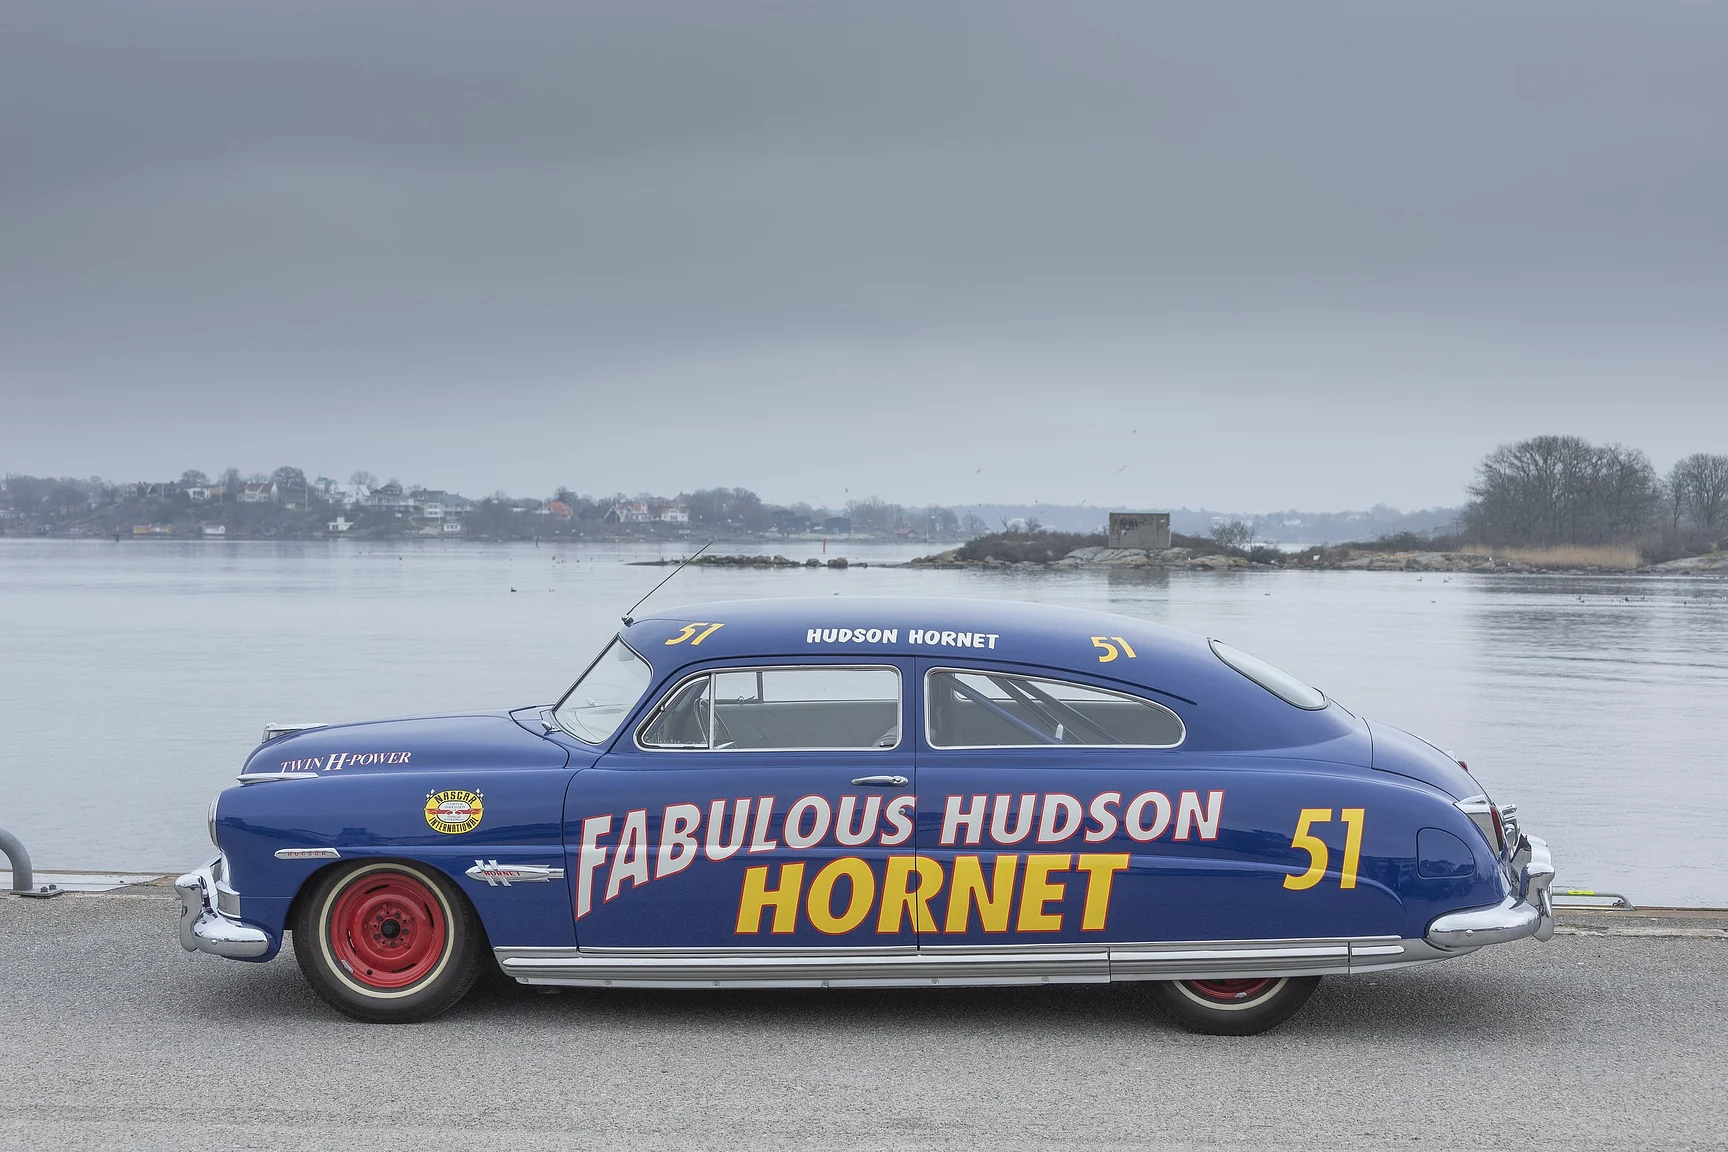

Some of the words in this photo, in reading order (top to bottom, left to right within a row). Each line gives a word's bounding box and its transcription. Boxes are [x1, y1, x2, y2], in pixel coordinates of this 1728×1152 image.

[665, 622, 725, 647] 51
[806, 628, 898, 644] HUDSON
[908, 629, 1000, 651] HORNET
[1090, 635, 1138, 663] 51
[280, 757, 324, 773] TWIN
[323, 751, 412, 771] H-POWER
[433, 791, 478, 804] NASCAR
[428, 816, 479, 833] INTERNATIONAL
[575, 793, 917, 922] FABULOUS
[938, 789, 1225, 846] HUDSON
[1282, 807, 1365, 890] 51
[734, 851, 1132, 935] HORNET
